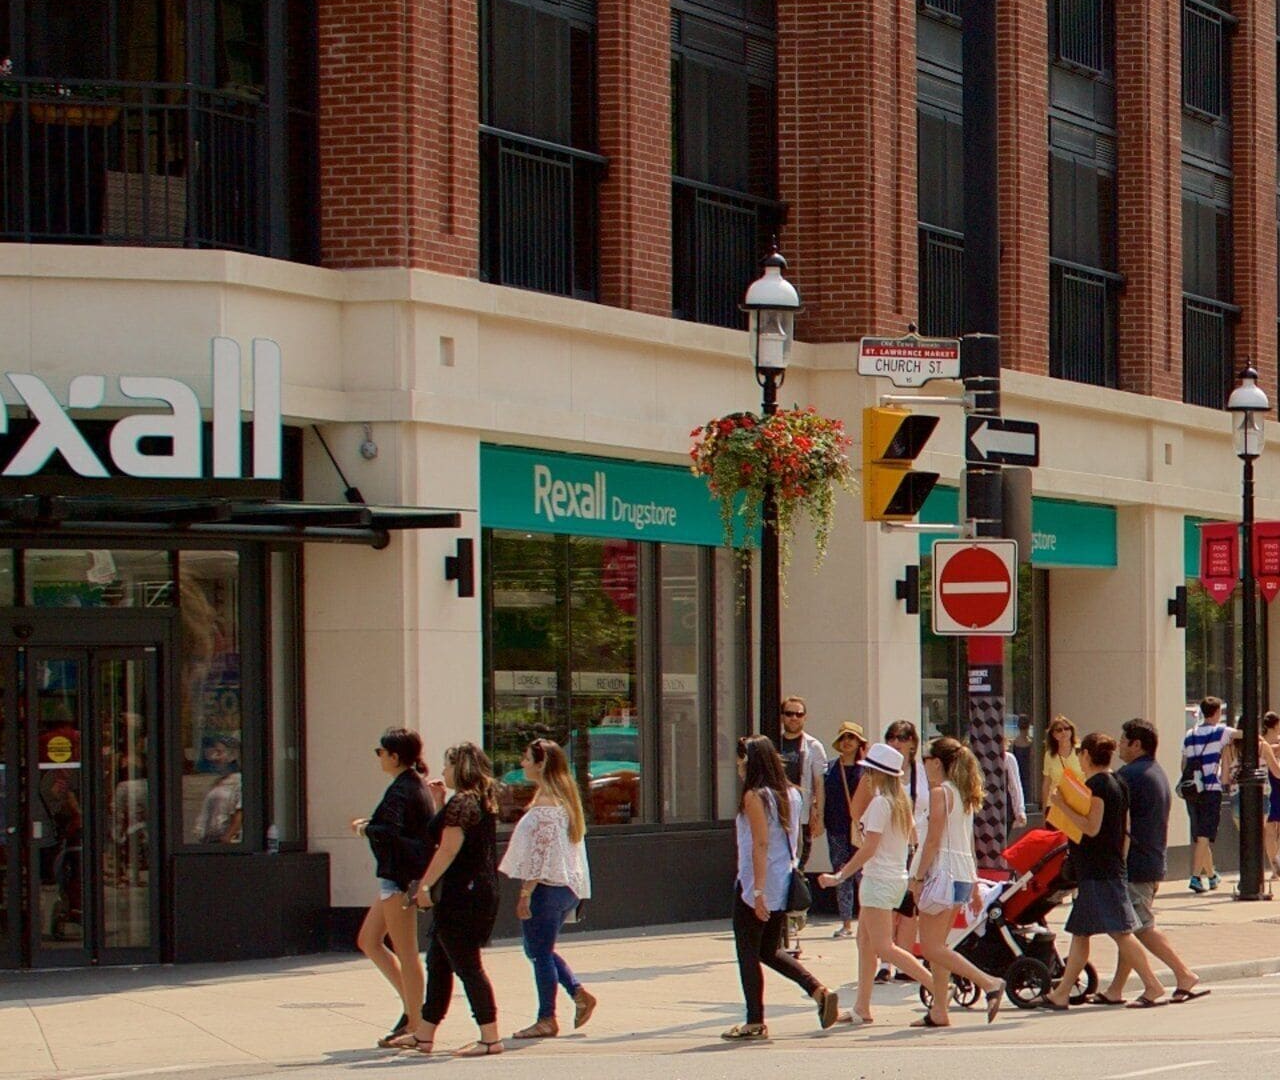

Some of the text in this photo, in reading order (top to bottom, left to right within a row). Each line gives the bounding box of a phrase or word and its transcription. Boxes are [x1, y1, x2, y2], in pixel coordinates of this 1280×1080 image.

[875, 359, 943, 375] CHURCH ST.
[880, 348, 922, 357] LAWRENCE
[924, 350, 955, 358] MARKET
[0, 336, 282, 480] xall
[534, 464, 677, 530] Rexall Drugstore
